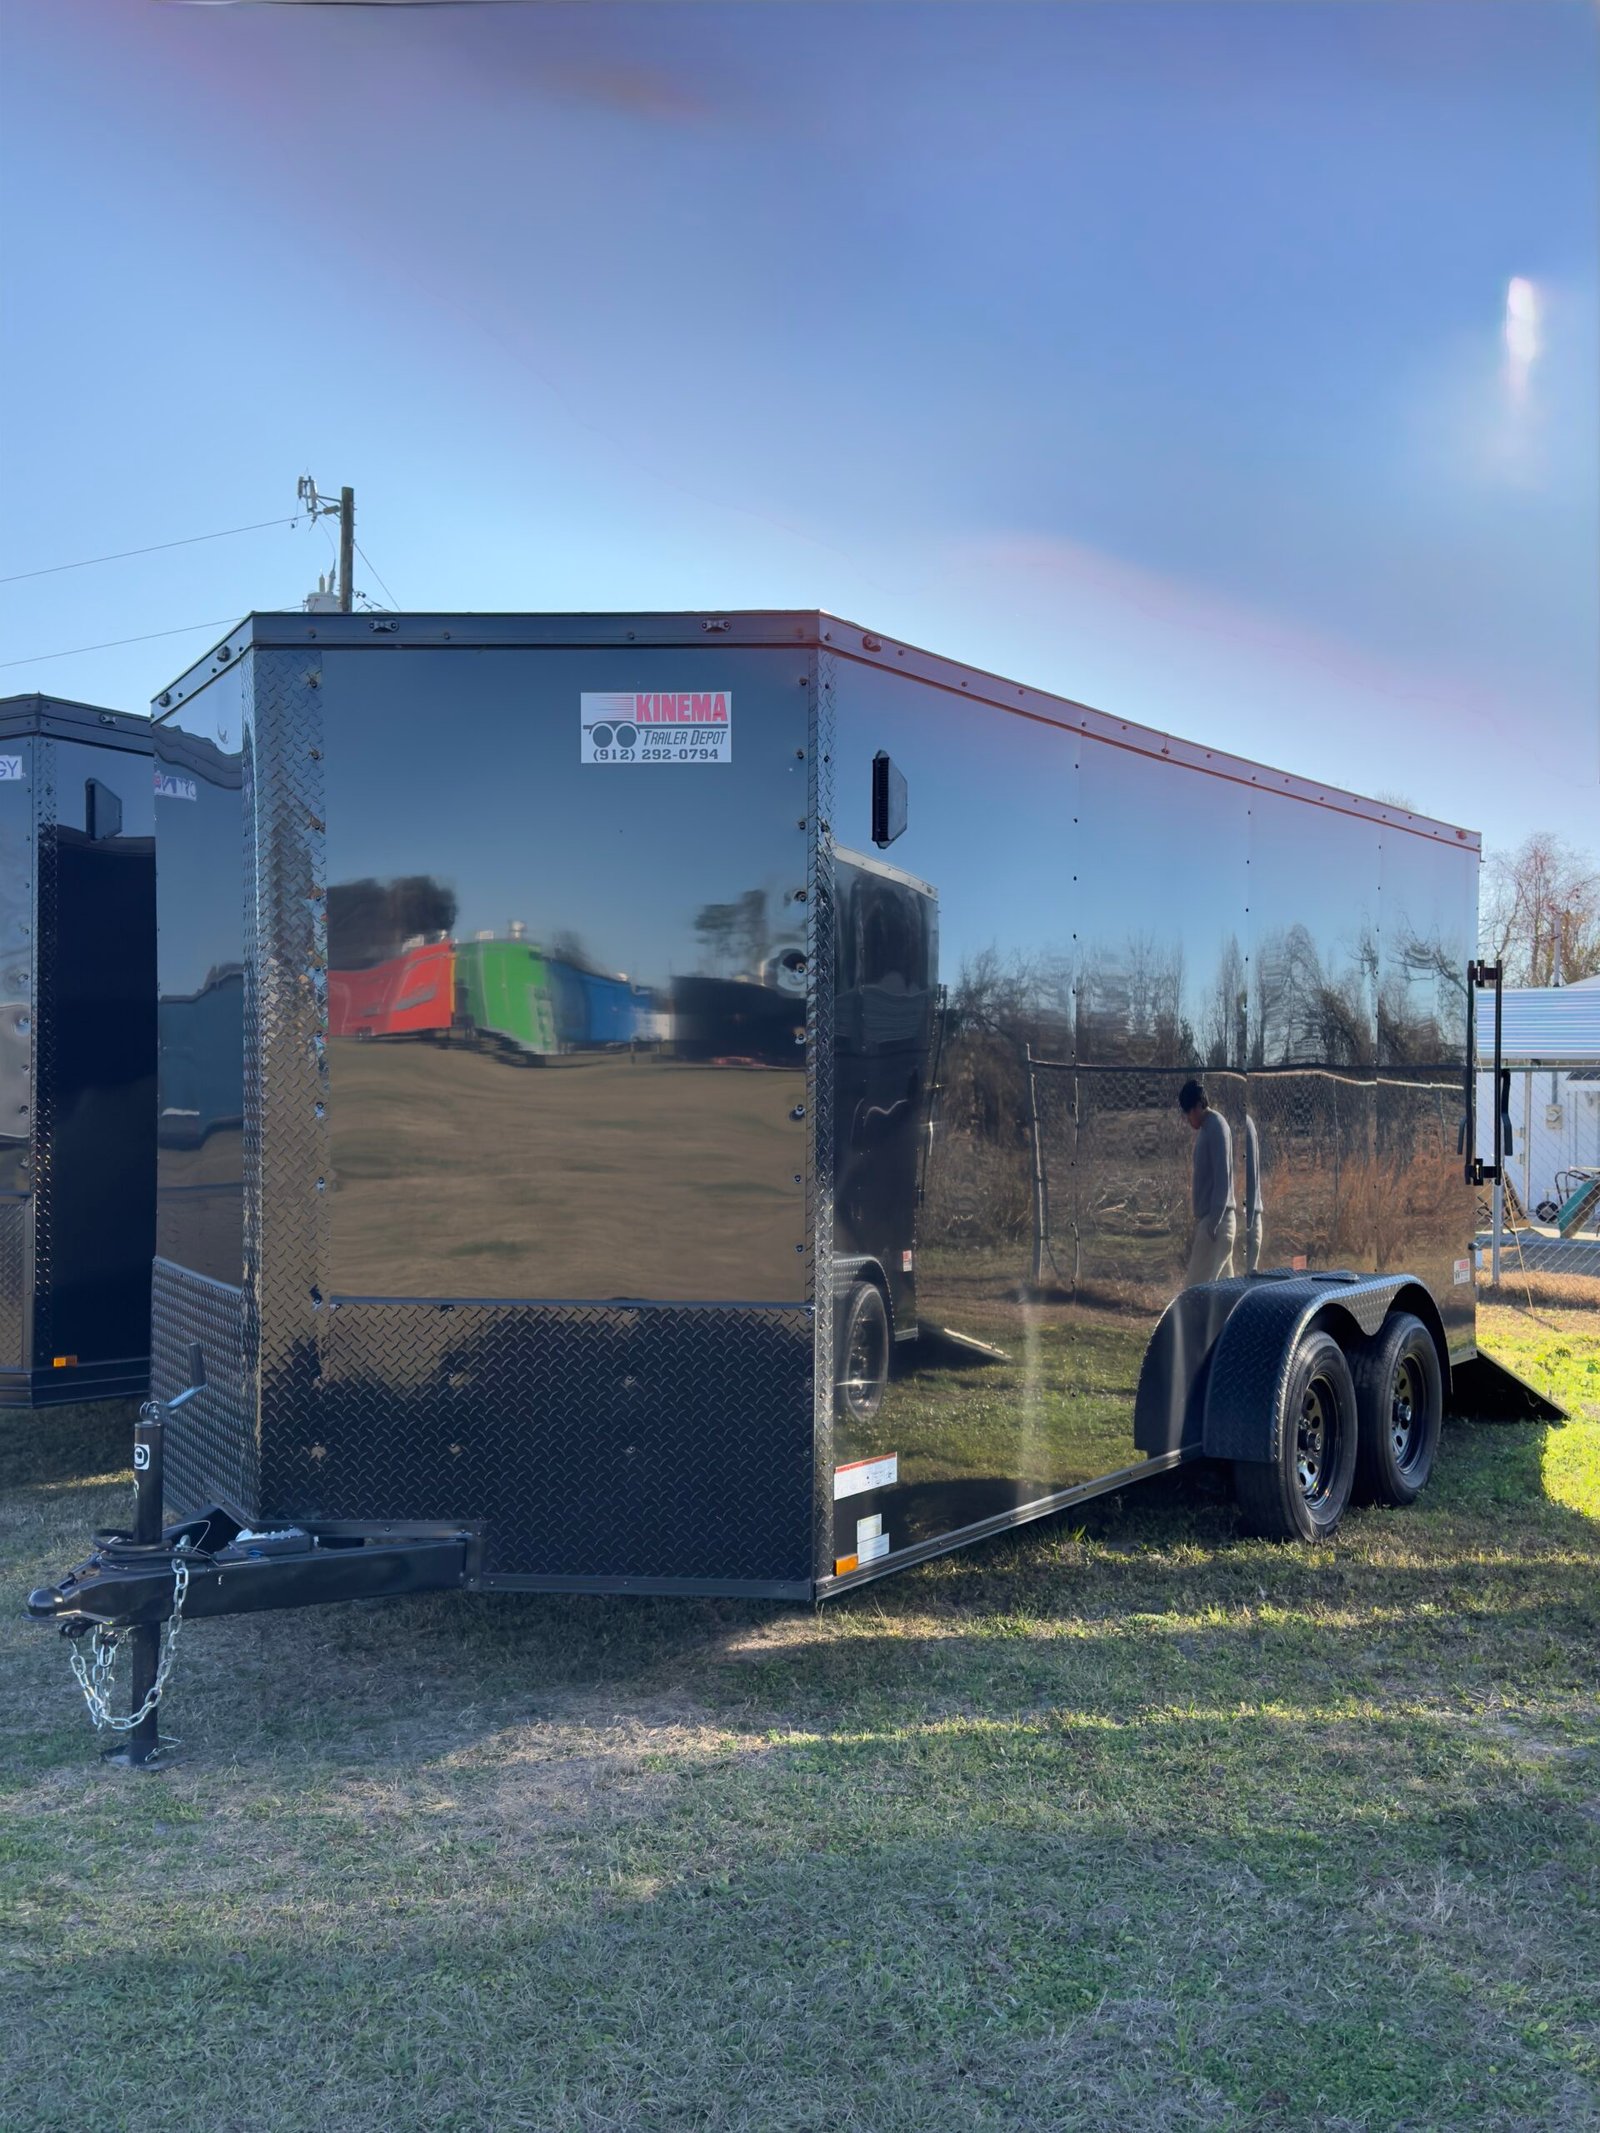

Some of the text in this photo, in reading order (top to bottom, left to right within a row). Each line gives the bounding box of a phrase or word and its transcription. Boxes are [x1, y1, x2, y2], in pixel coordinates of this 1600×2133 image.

[636, 693, 728, 722] KINEMA
[643, 729, 727, 746] TRAILER DEPOT
[593, 748, 718, 762] (912) 292-0794
